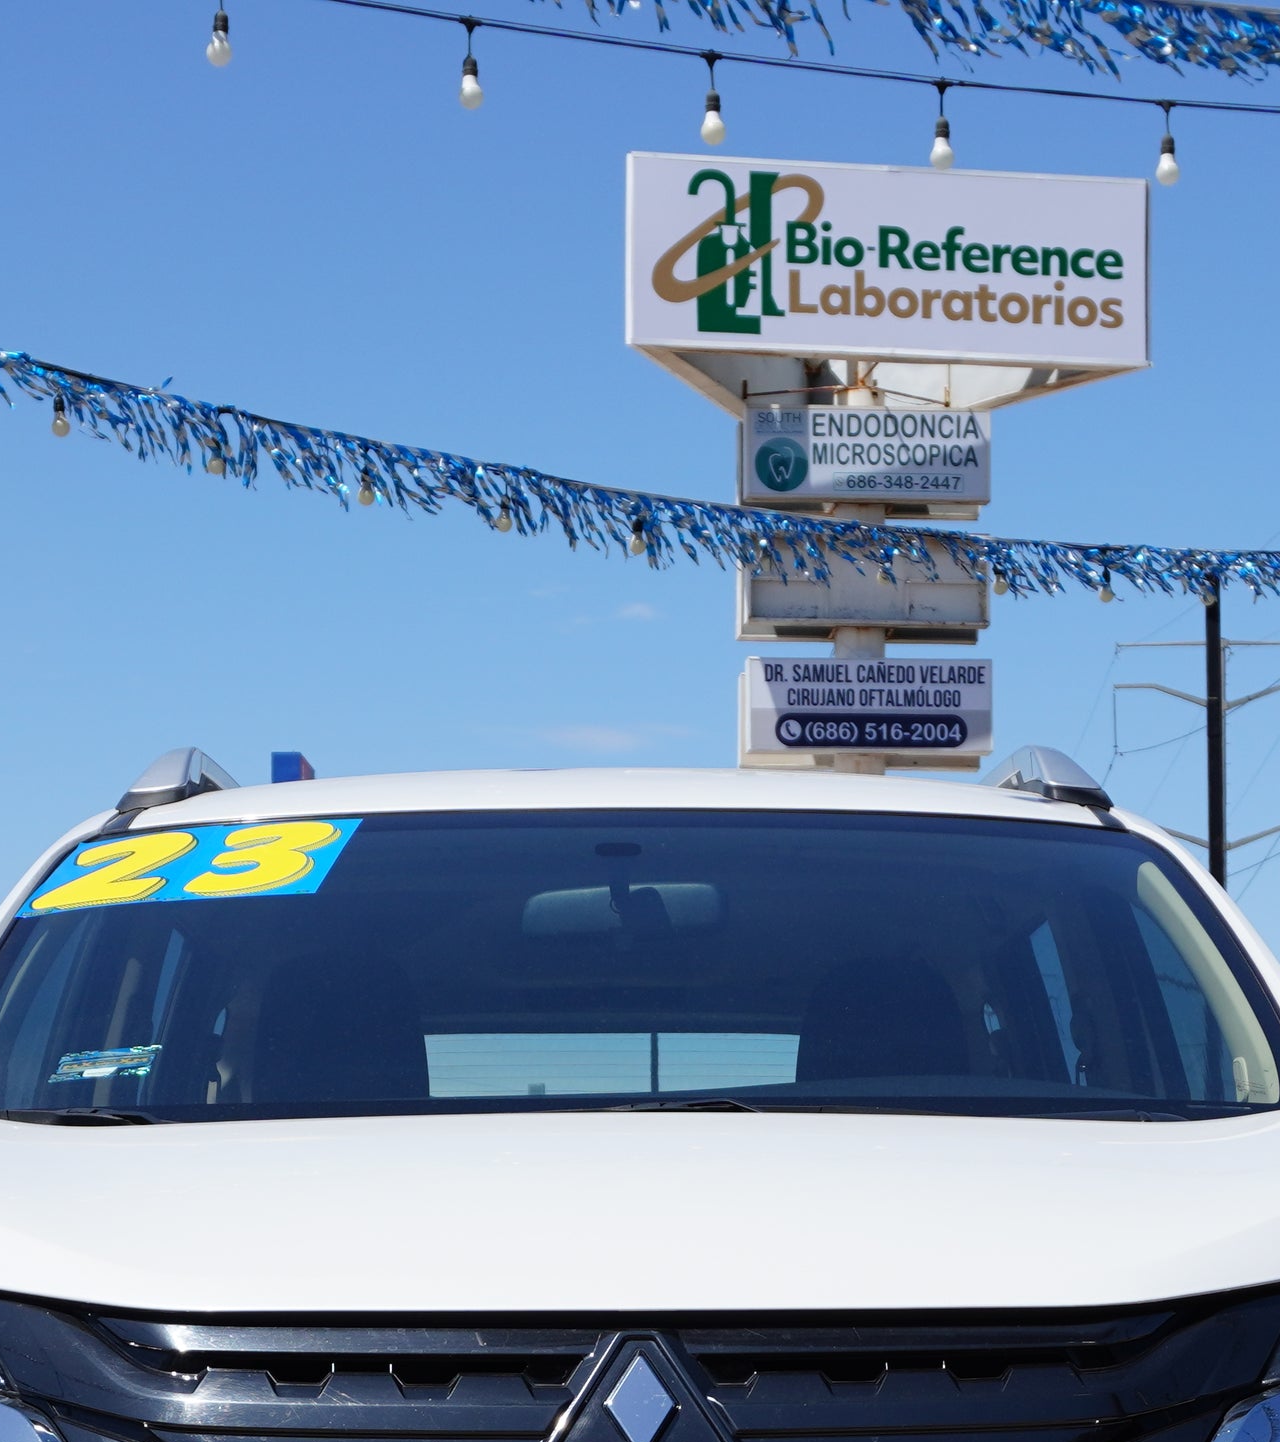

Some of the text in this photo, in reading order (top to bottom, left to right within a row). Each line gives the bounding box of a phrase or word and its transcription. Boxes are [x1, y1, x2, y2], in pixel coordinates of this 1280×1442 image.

[786, 220, 1123, 280] Bio-Reference
[787, 269, 1124, 329] Laboratorios
[757, 411, 802, 424] SOUTH
[812, 413, 979, 439] ENDODONCIA
[812, 443, 979, 468] MICROSCOPICA
[846, 474, 961, 491] 686-348-2447
[764, 661, 986, 685] DR. SAMUEL CAÑEDO VELARDE
[787, 685, 961, 708] CIRUJANO OFTALMÓLOGO
[804, 721, 962, 743] (686) 516-2004
[31, 821, 342, 911] 23
